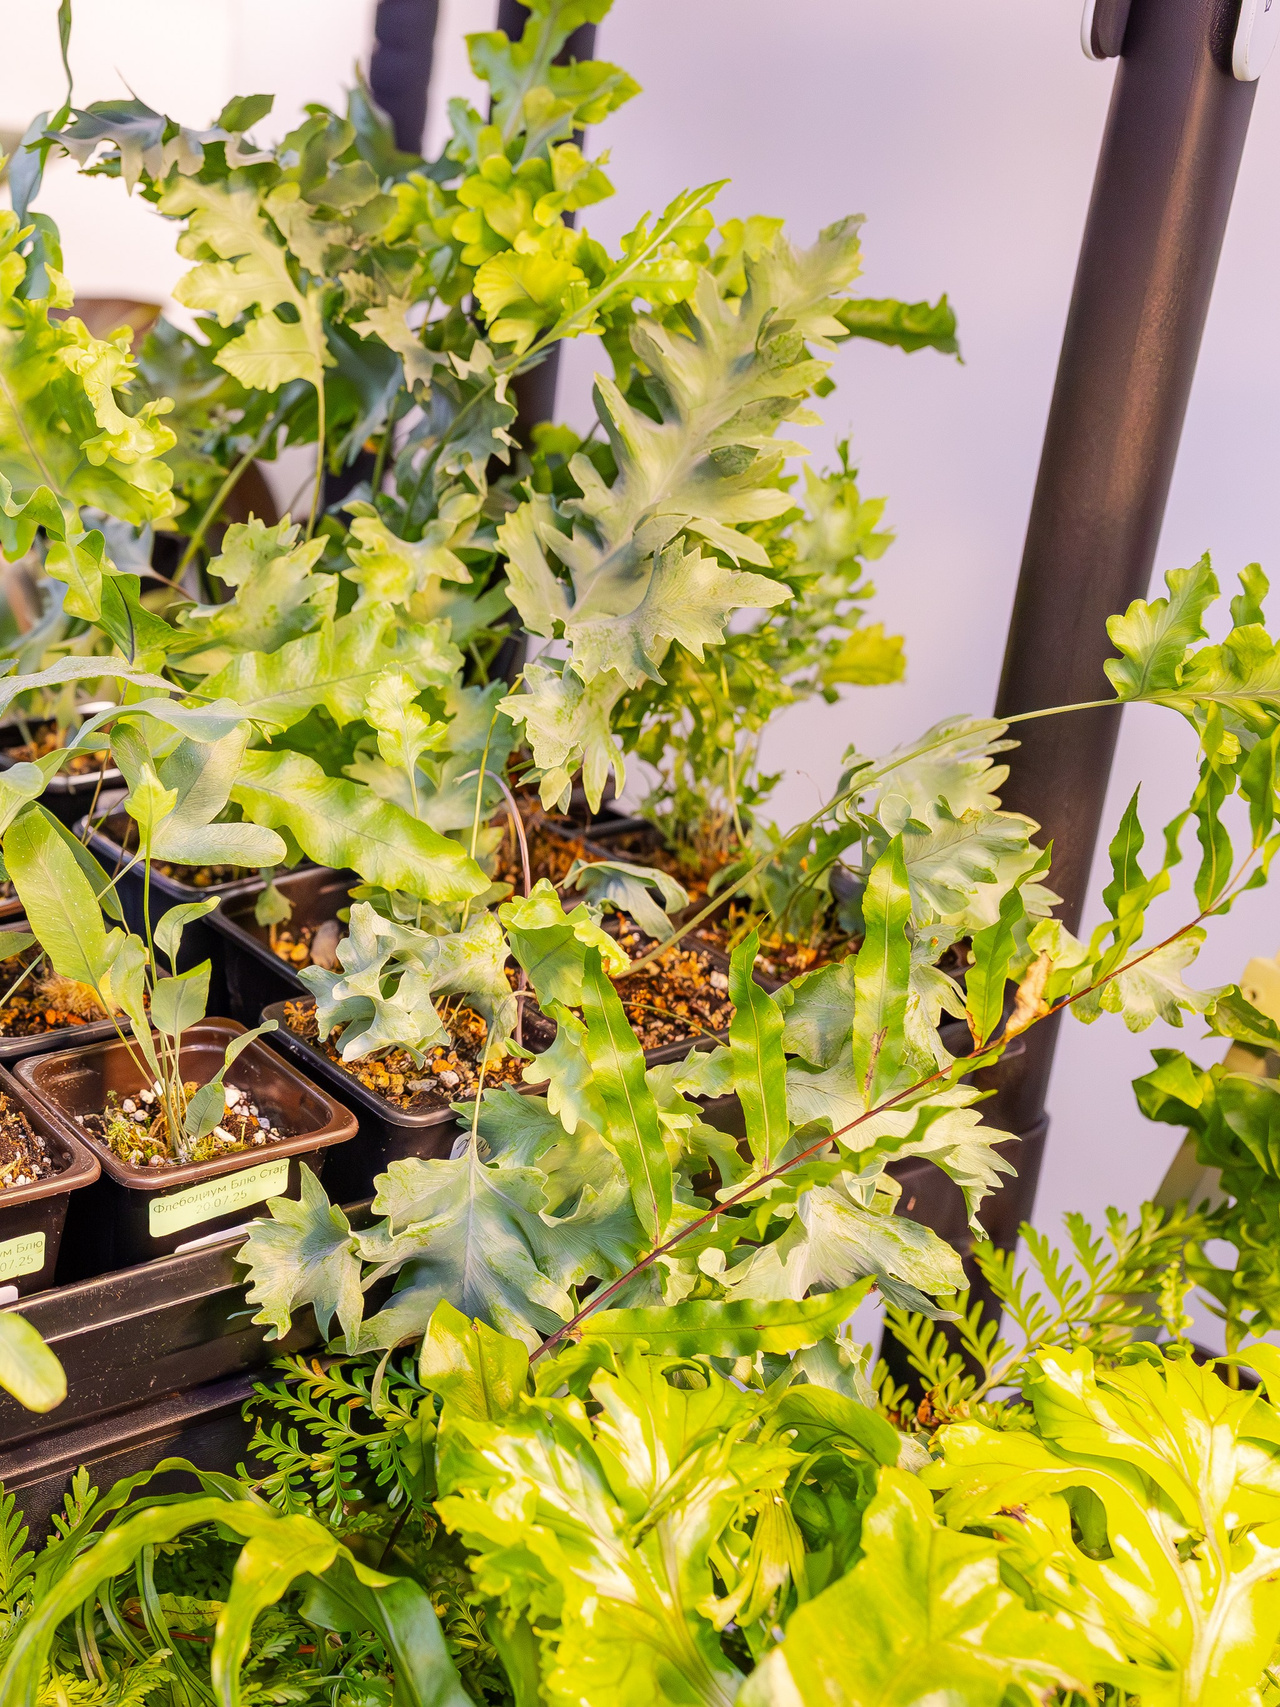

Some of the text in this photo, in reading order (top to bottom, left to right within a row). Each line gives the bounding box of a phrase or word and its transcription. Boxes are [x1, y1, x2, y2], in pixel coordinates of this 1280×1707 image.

[153, 1163, 288, 1214] Флебодиум Блю Стар
[16, 1239, 43, 1254] Блю
